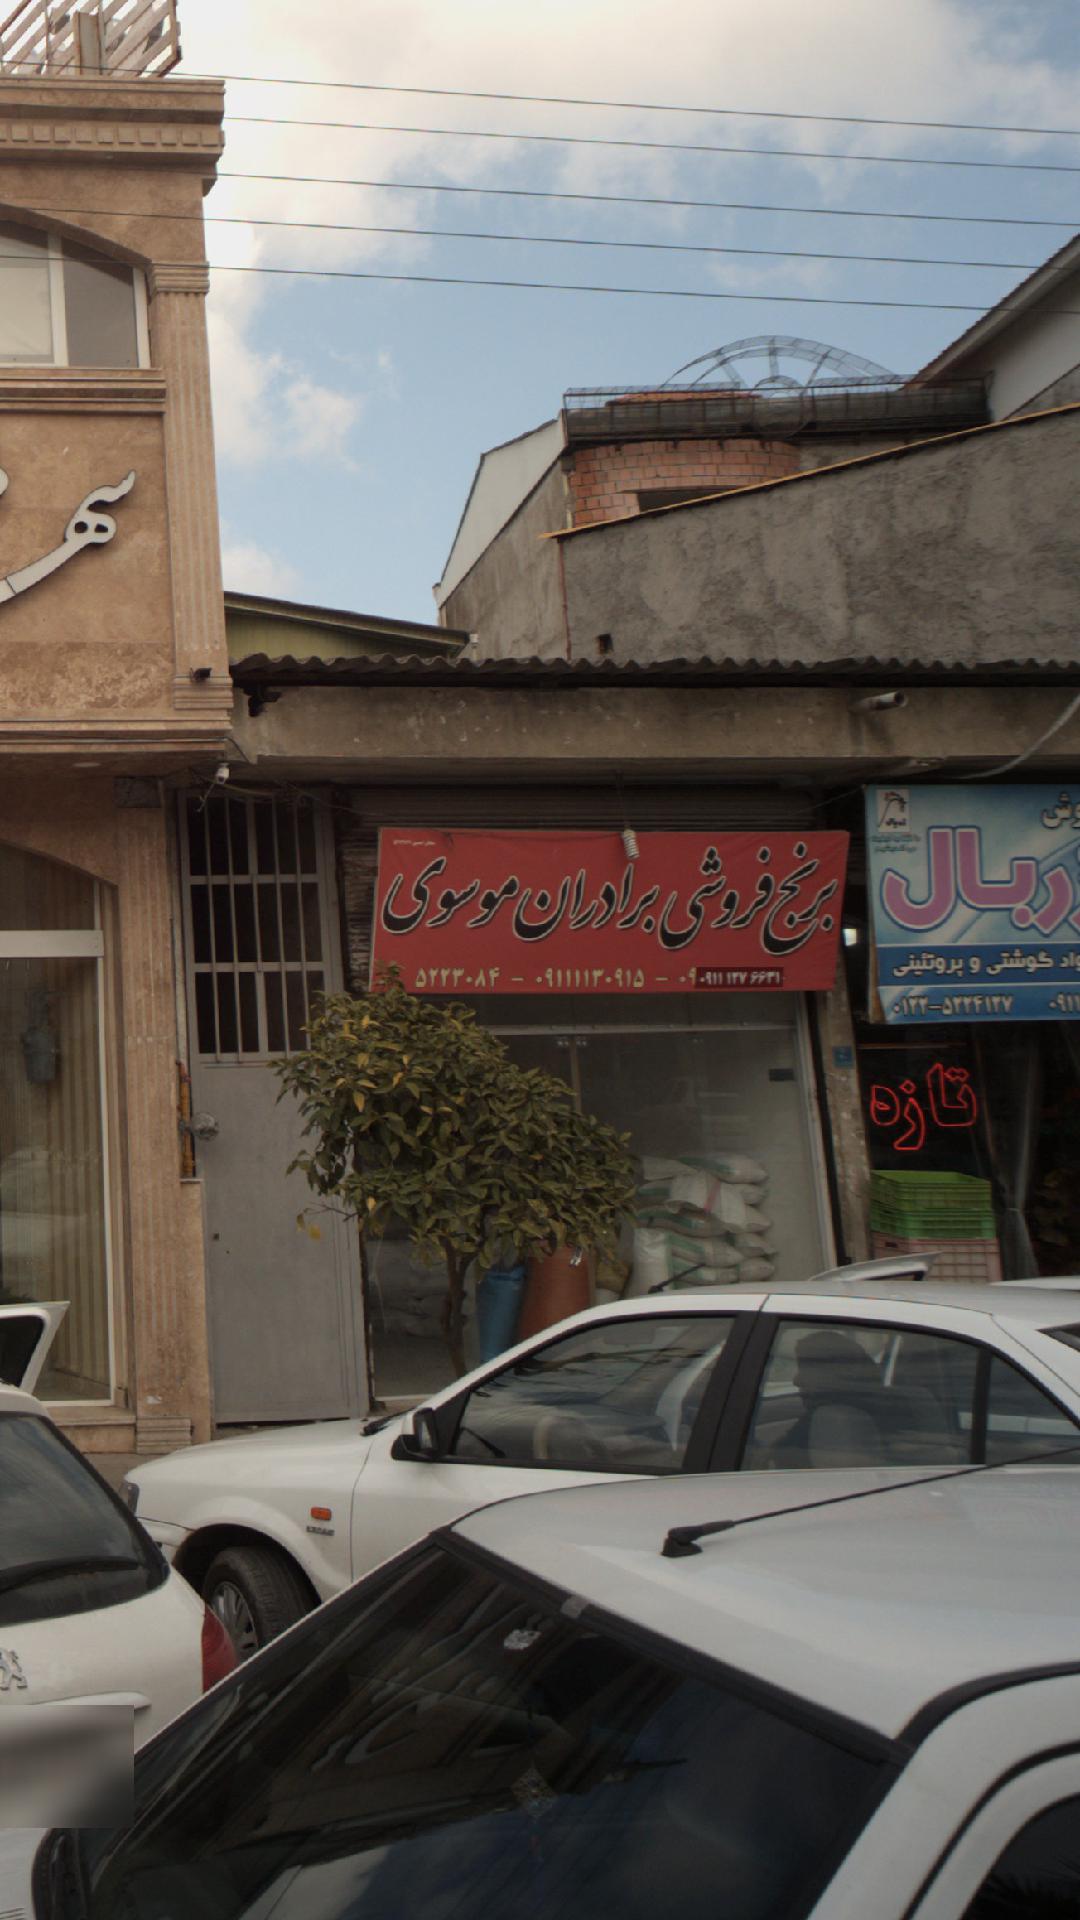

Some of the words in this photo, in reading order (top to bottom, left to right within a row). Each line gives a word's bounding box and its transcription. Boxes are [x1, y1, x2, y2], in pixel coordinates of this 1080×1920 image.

[381, 856, 519, 934] موسوی
[512, 862, 659, 941] برادران
[658, 846, 775, 950] فروشی
[760, 842, 838, 955] برنج
[415, 967, 500, 989] ۵۲۲۳۰۸۴
[536, 967, 646, 988] ۰۹۱۱۱۱۳۰۹۱۵
[969, 956, 982, 974] و
[986, 949, 1054, 975] گوشتی
[870, 1061, 977, 1151] تازه
